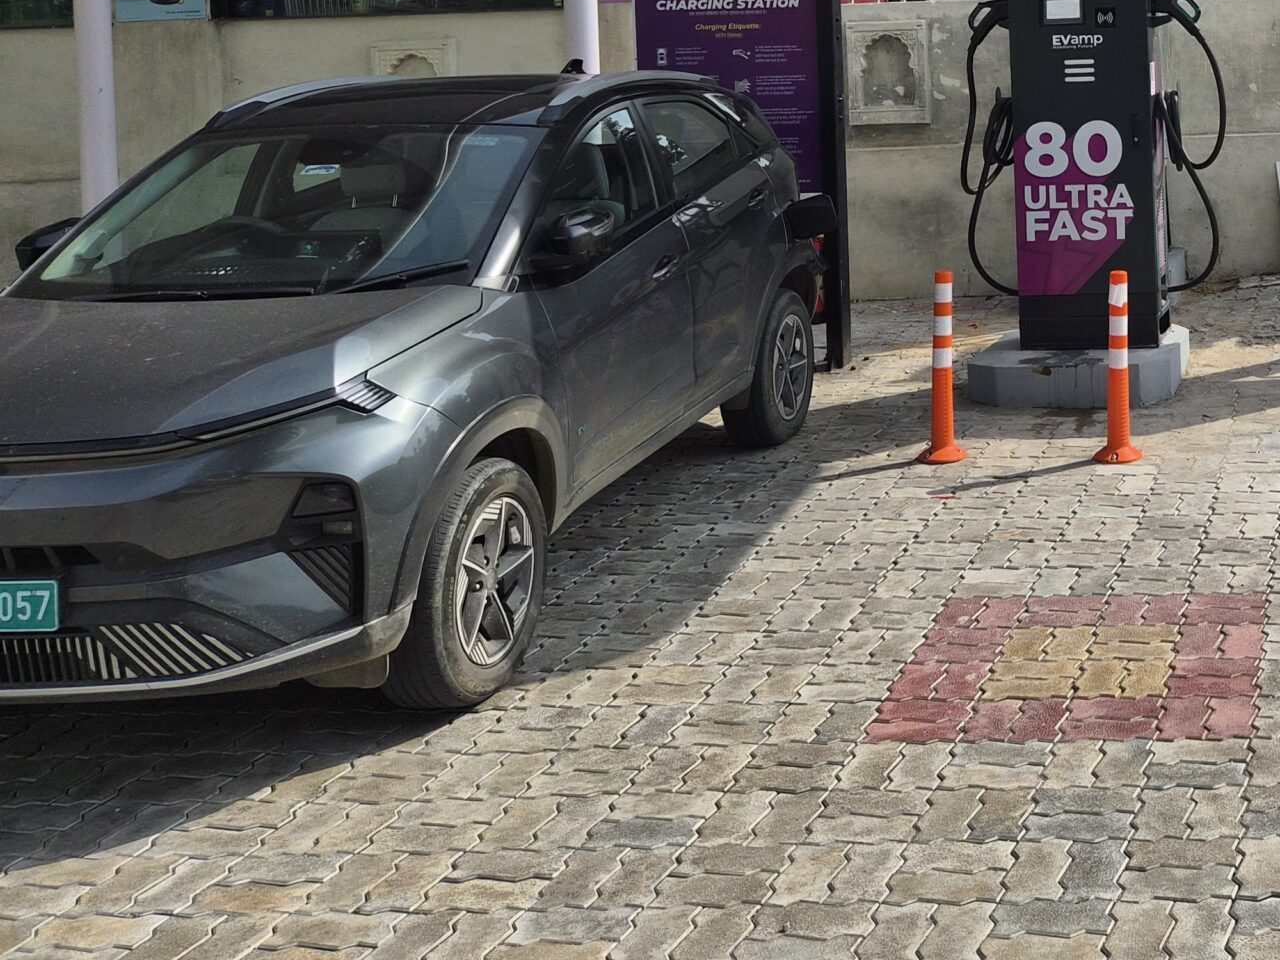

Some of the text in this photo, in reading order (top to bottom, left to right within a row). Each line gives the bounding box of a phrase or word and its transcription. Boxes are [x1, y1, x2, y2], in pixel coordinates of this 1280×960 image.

[656, 0, 734, 11] CHARGING
[1052, 34, 1103, 46] EVamp
[1024, 120, 1123, 177] 80
[1024, 183, 1134, 209] ULTRA
[1026, 209, 1134, 242] FAST
[0, 590, 50, 621] 057
